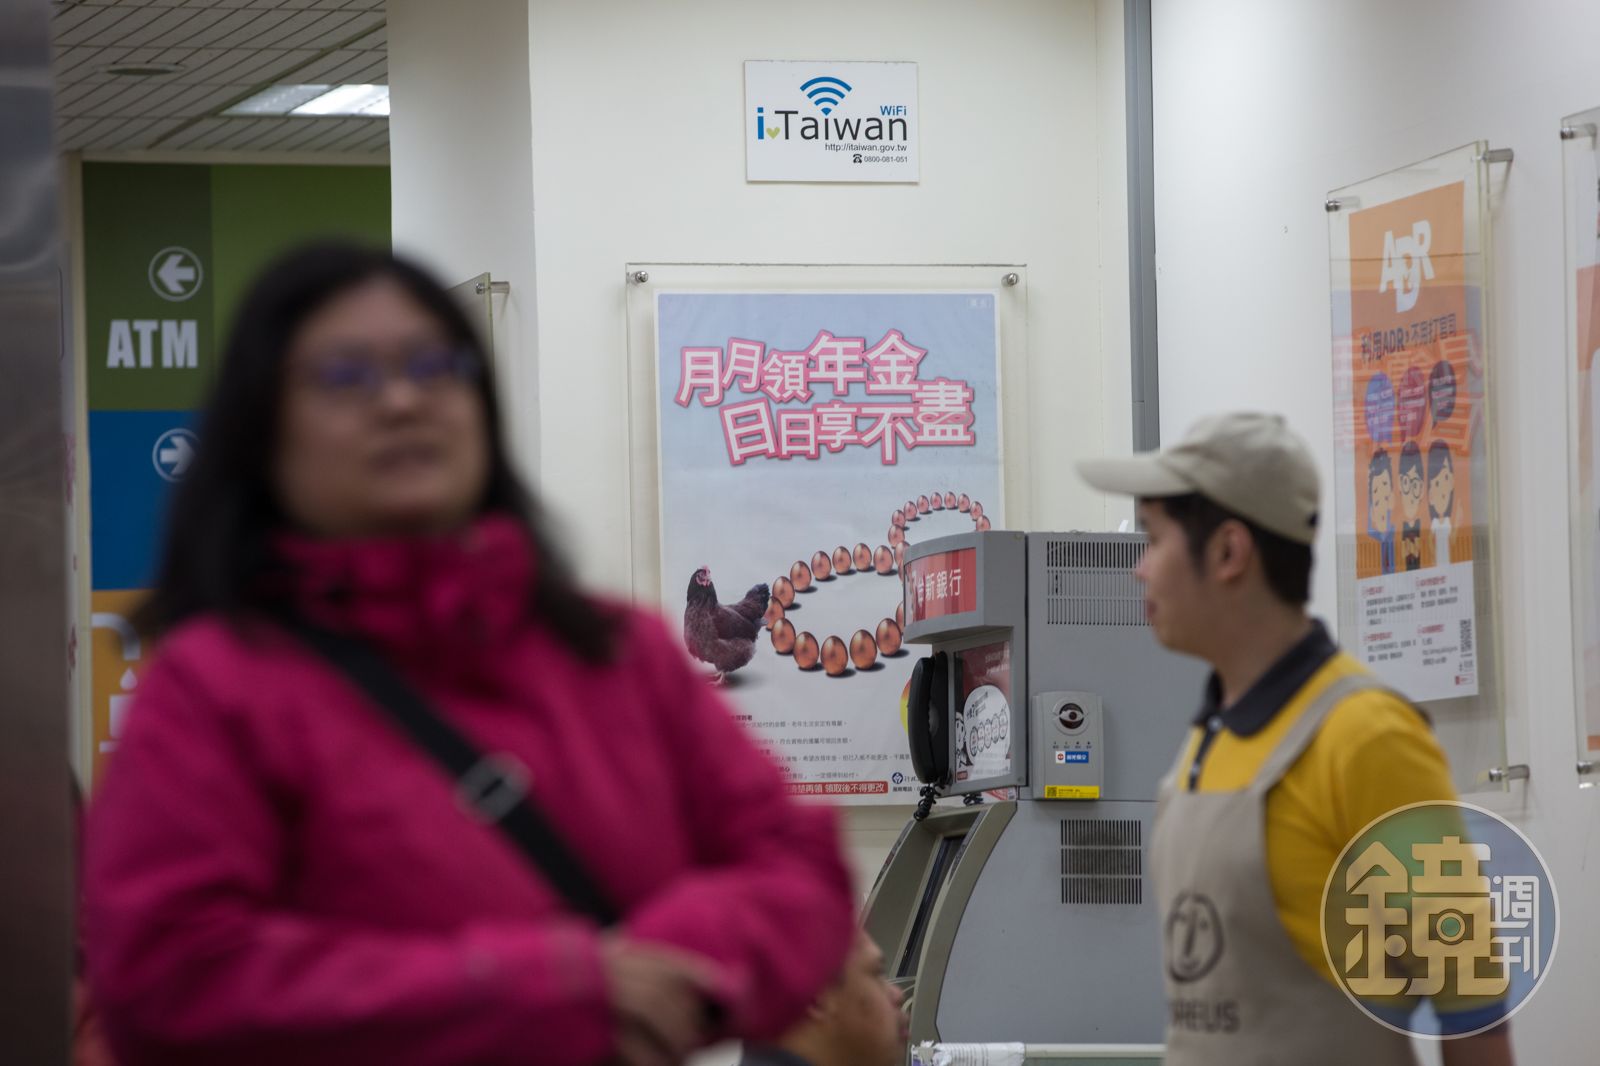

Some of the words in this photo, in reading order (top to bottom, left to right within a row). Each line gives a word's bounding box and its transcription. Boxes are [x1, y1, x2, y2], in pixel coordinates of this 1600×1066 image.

[880, 105, 907, 116] WiFi
[825, 143, 908, 153] http://itaiwan.gov.tw
[106, 319, 199, 369] ATM
[674, 328, 928, 407] 月月領年金
[720, 377, 977, 467] 日日享不盡
